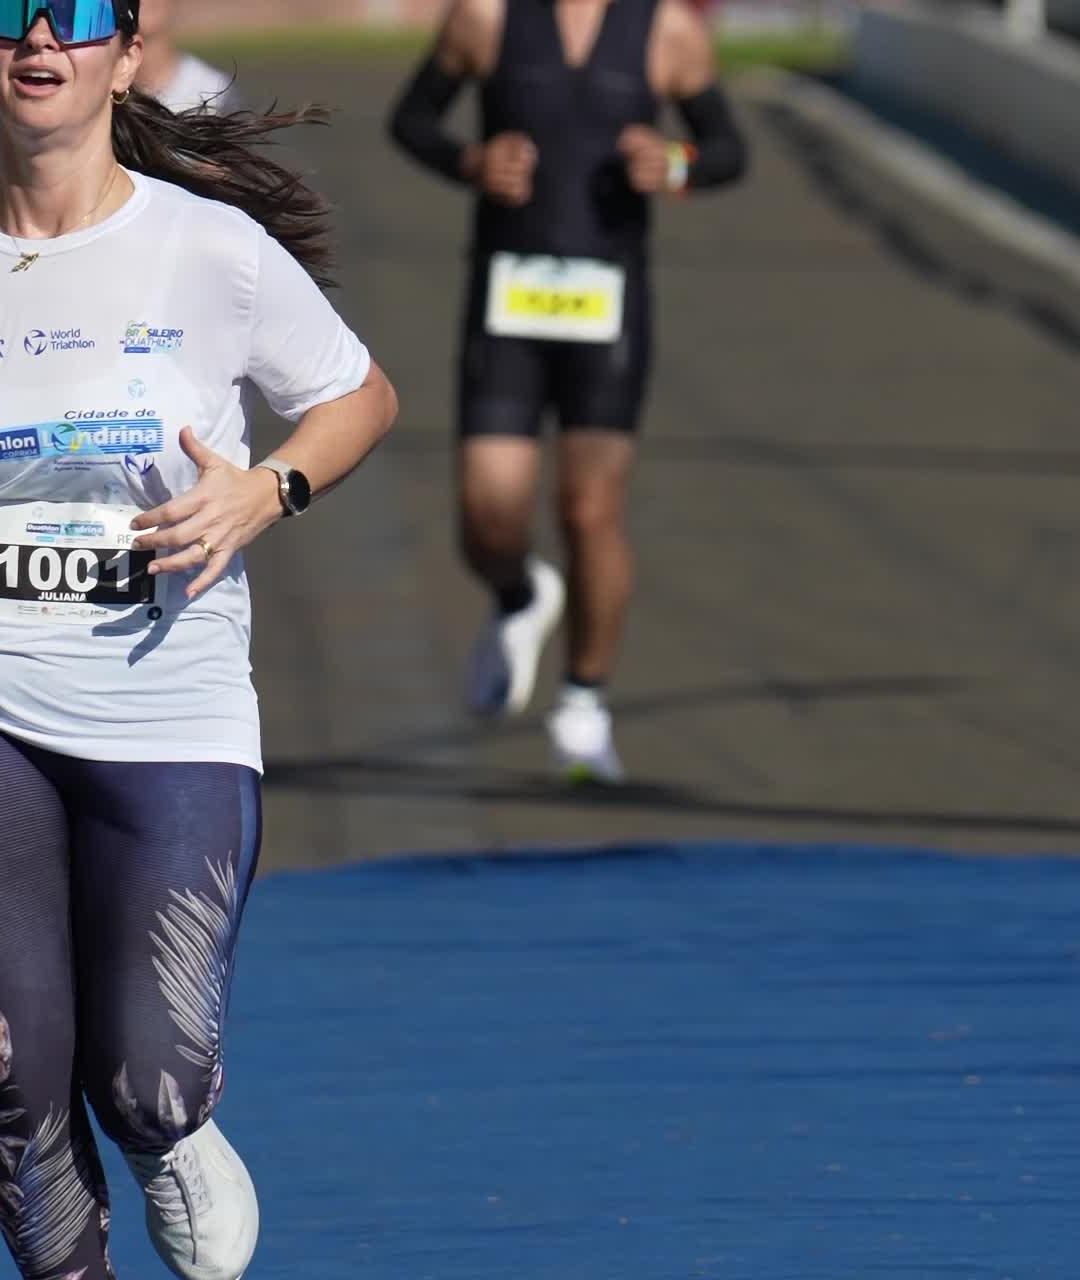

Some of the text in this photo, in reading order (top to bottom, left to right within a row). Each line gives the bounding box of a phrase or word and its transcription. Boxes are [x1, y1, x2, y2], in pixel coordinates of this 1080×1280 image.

[50, 328, 81, 339] World
[50, 339, 95, 351] Triathlon
[125, 337, 183, 347] DUATHLN
[64, 408, 156, 420] Cidade de
[38, 591, 88, 601] JULIANA
